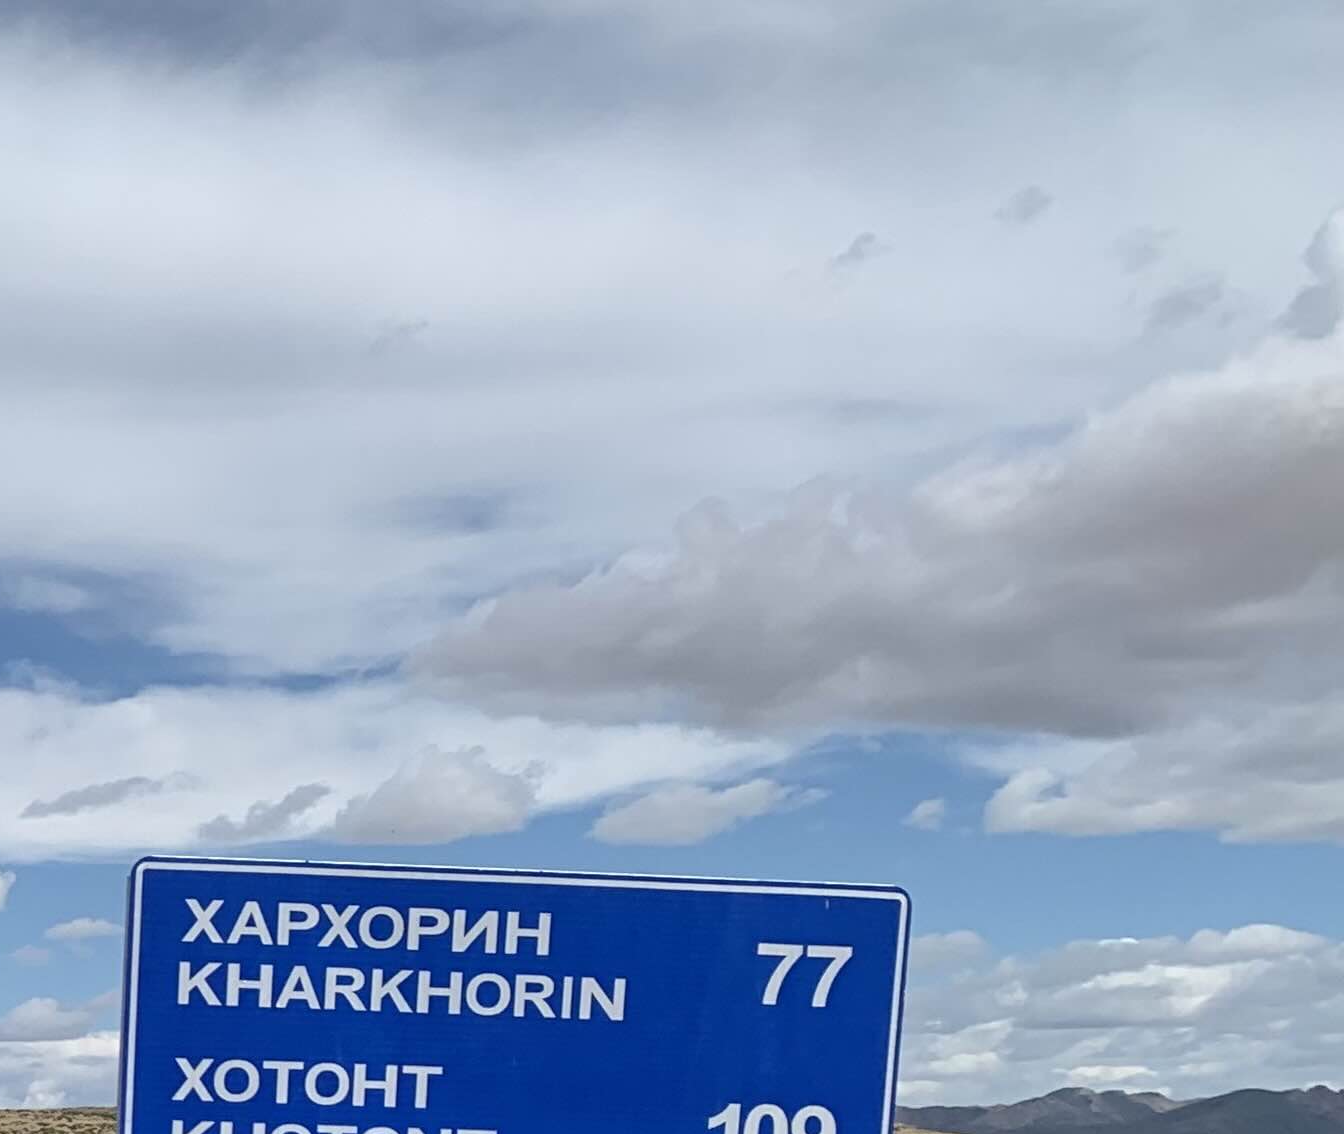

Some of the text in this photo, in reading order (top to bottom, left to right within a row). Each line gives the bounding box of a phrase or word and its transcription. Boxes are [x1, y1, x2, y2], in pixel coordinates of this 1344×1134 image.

[183, 898, 551, 956] ХАРХОРИН
[177, 961, 626, 1021] KHARKHORIN
[757, 942, 853, 1008] 77
[172, 1057, 443, 1109] ХОТОНТ
